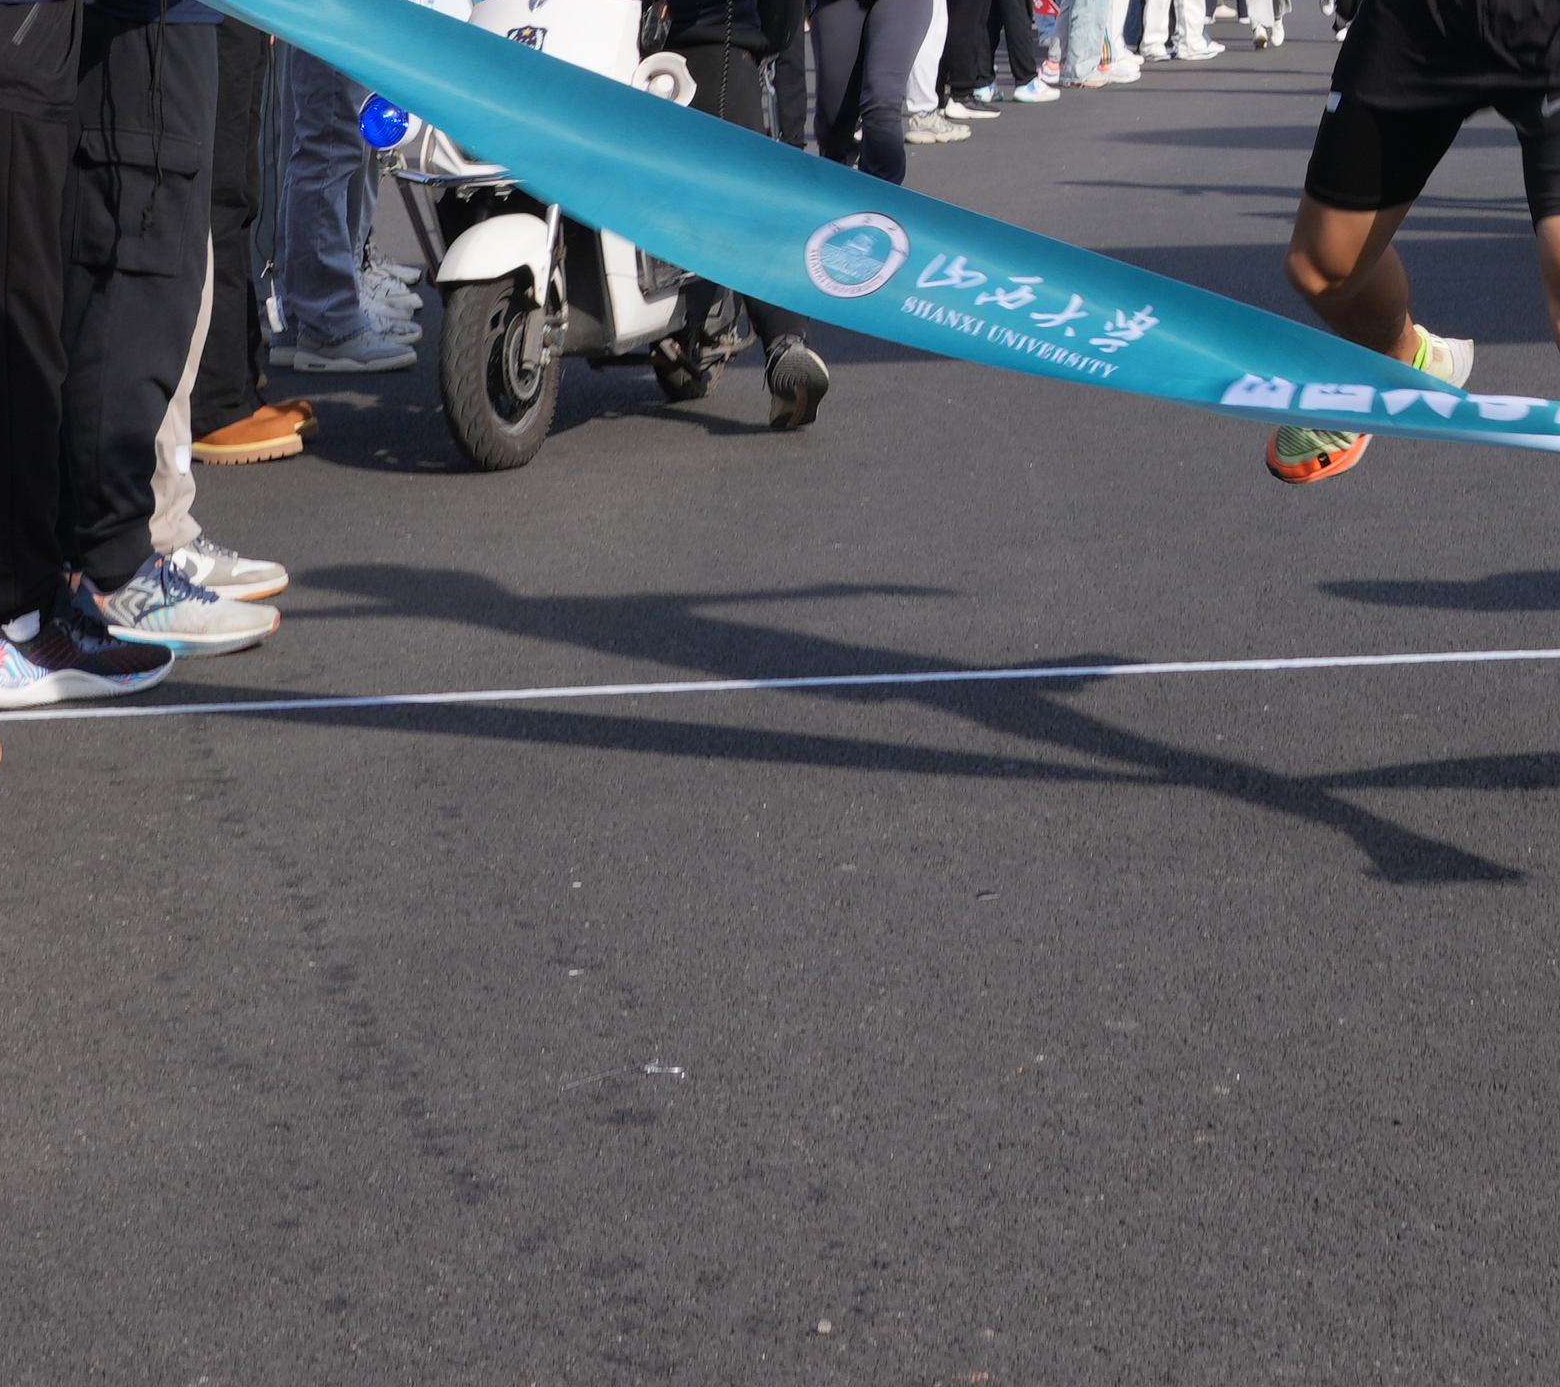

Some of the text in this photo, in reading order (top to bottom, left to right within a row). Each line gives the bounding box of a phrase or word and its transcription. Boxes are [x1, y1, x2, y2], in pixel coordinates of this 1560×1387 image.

[899, 295, 1121, 379] SHANXI UNIVERSITY
[915, 252, 1161, 354] 山西大学
